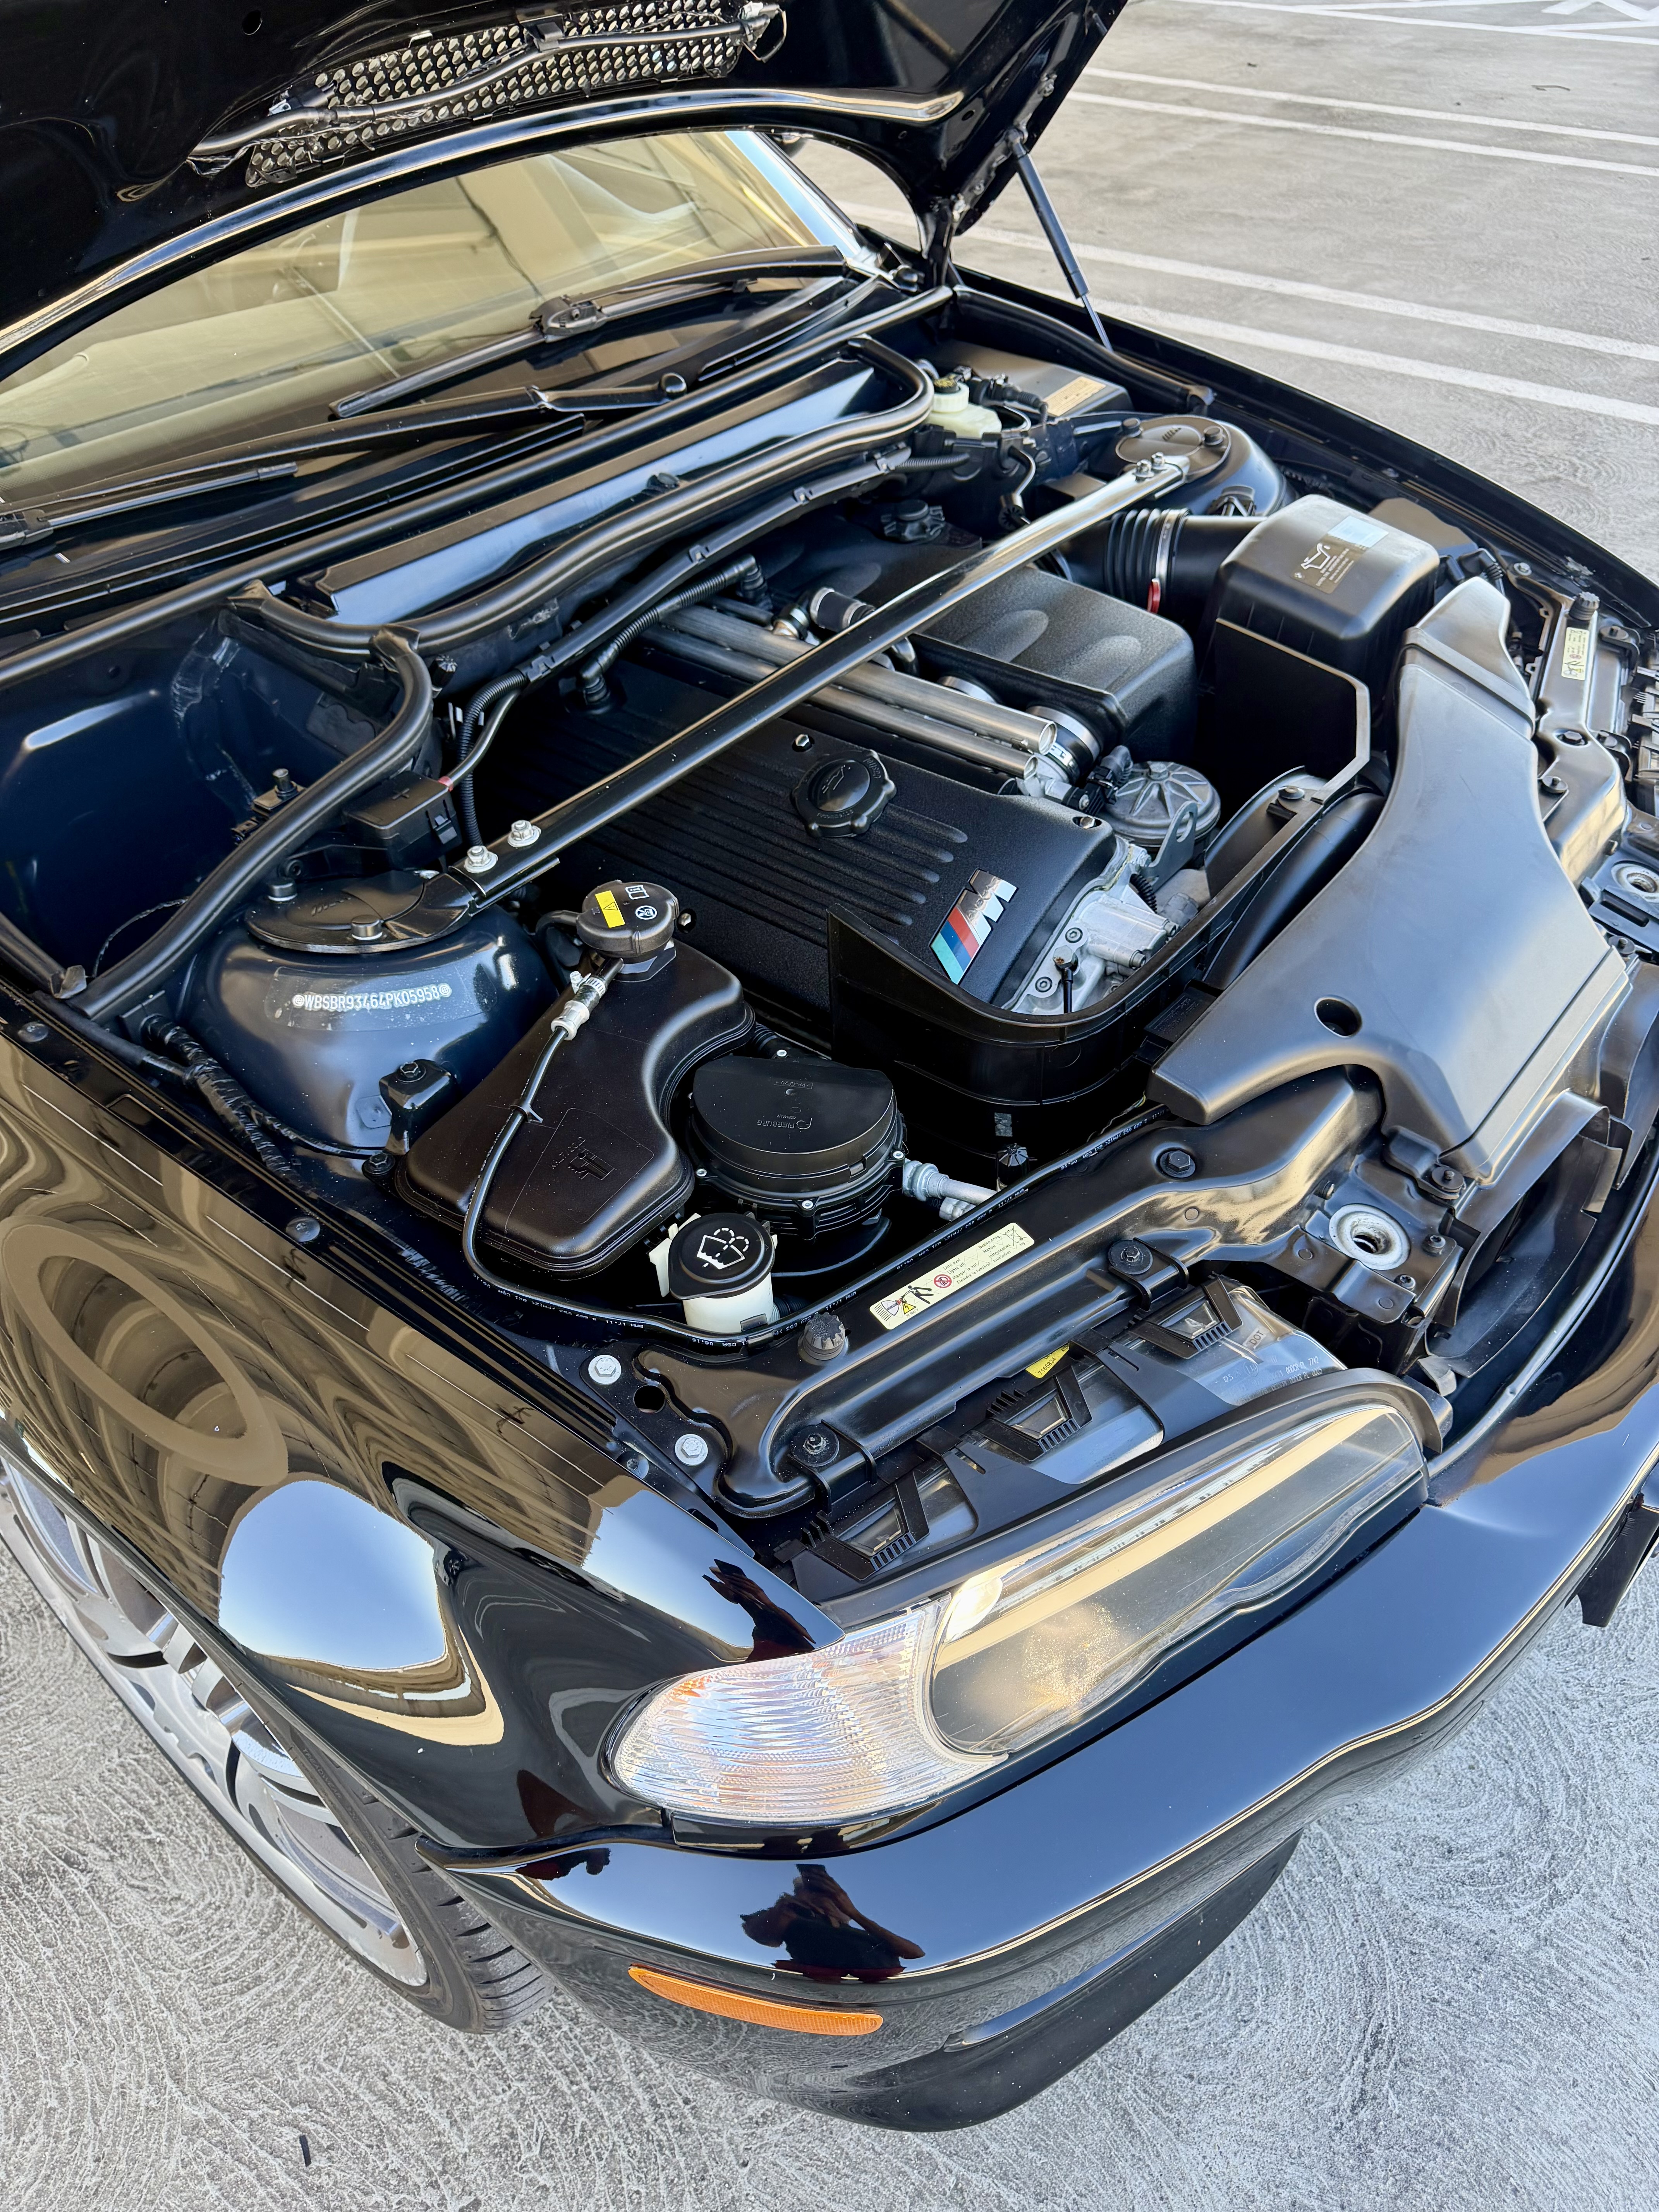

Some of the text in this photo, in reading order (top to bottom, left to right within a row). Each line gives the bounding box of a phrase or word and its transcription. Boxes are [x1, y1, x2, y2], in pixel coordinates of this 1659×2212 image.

[305, 988, 440, 1009] WBSBR93464PK05958
[1249, 1331, 1264, 1345] DOT
[1037, 1356, 1056, 1376] 7165824
